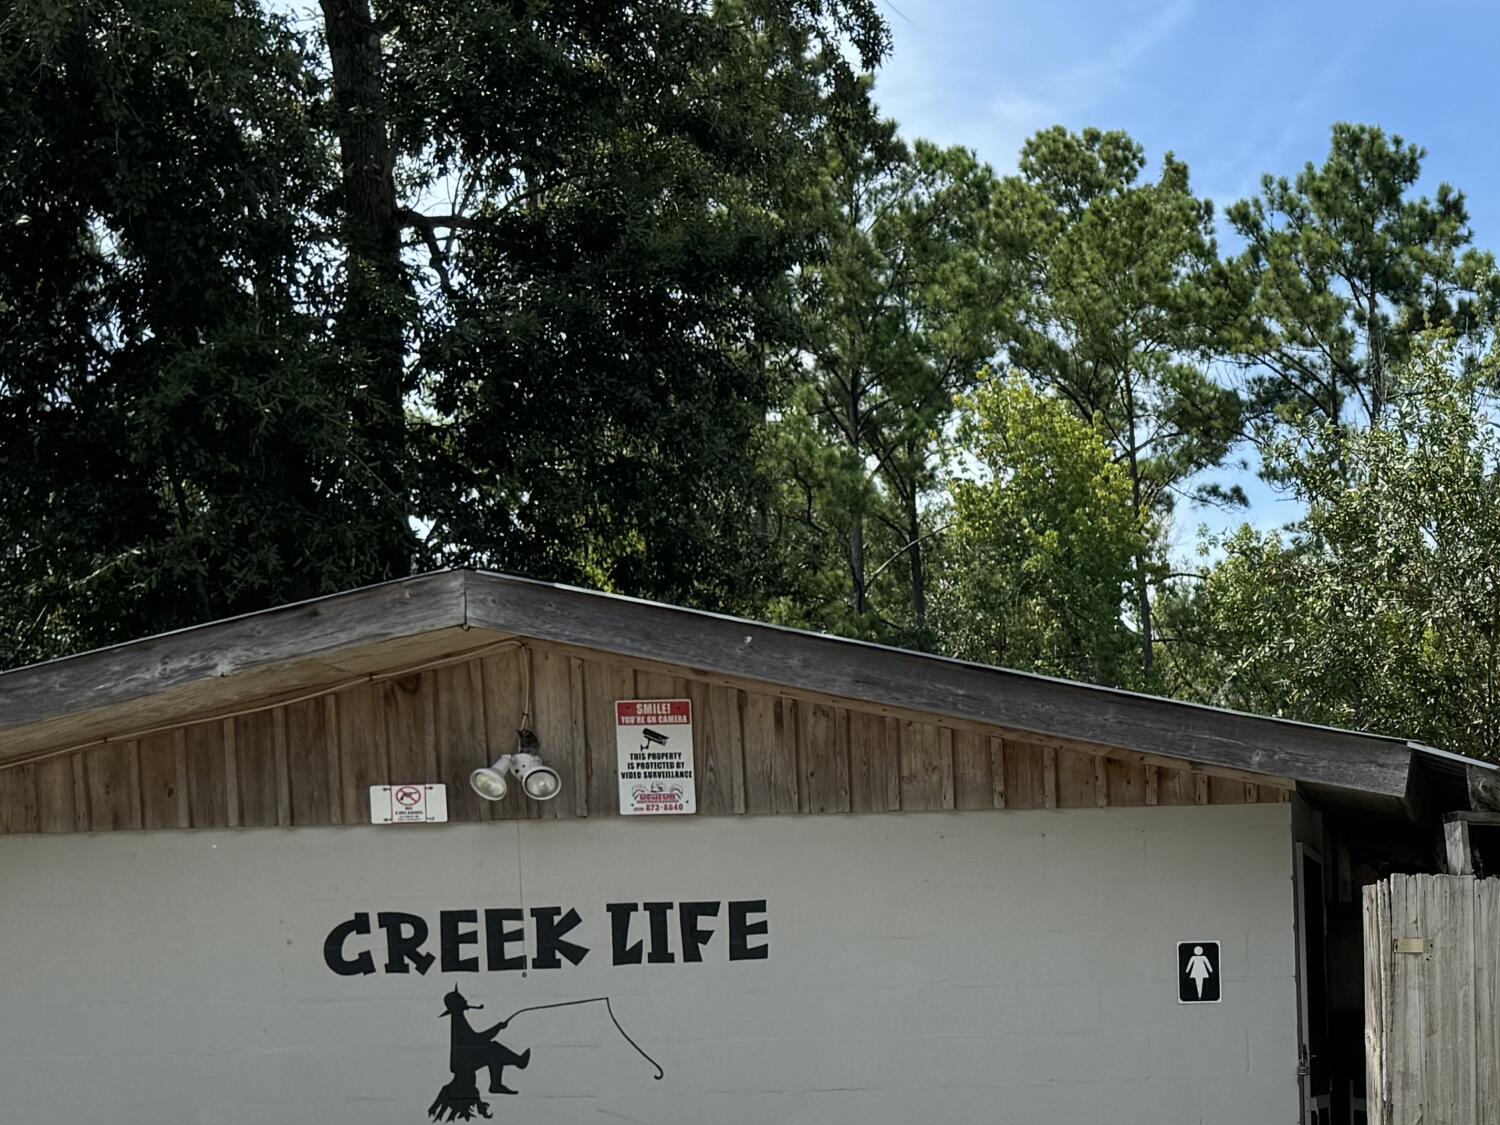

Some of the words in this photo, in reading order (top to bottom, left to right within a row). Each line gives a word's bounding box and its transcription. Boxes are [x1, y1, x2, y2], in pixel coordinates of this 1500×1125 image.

[636, 703, 671, 715] SMILE!
[621, 716, 645, 724] YOU'RE
[646, 716, 657, 724] ON
[658, 715, 688, 723] CAMERA
[647, 752, 682, 760] PROPERTY
[627, 762, 635, 770] IS
[636, 762, 675, 770] PROTECTED
[643, 771, 692, 779] SURVEILLANCE
[323, 907, 590, 976] CREEK
[606, 900, 769, 966] LIFE
